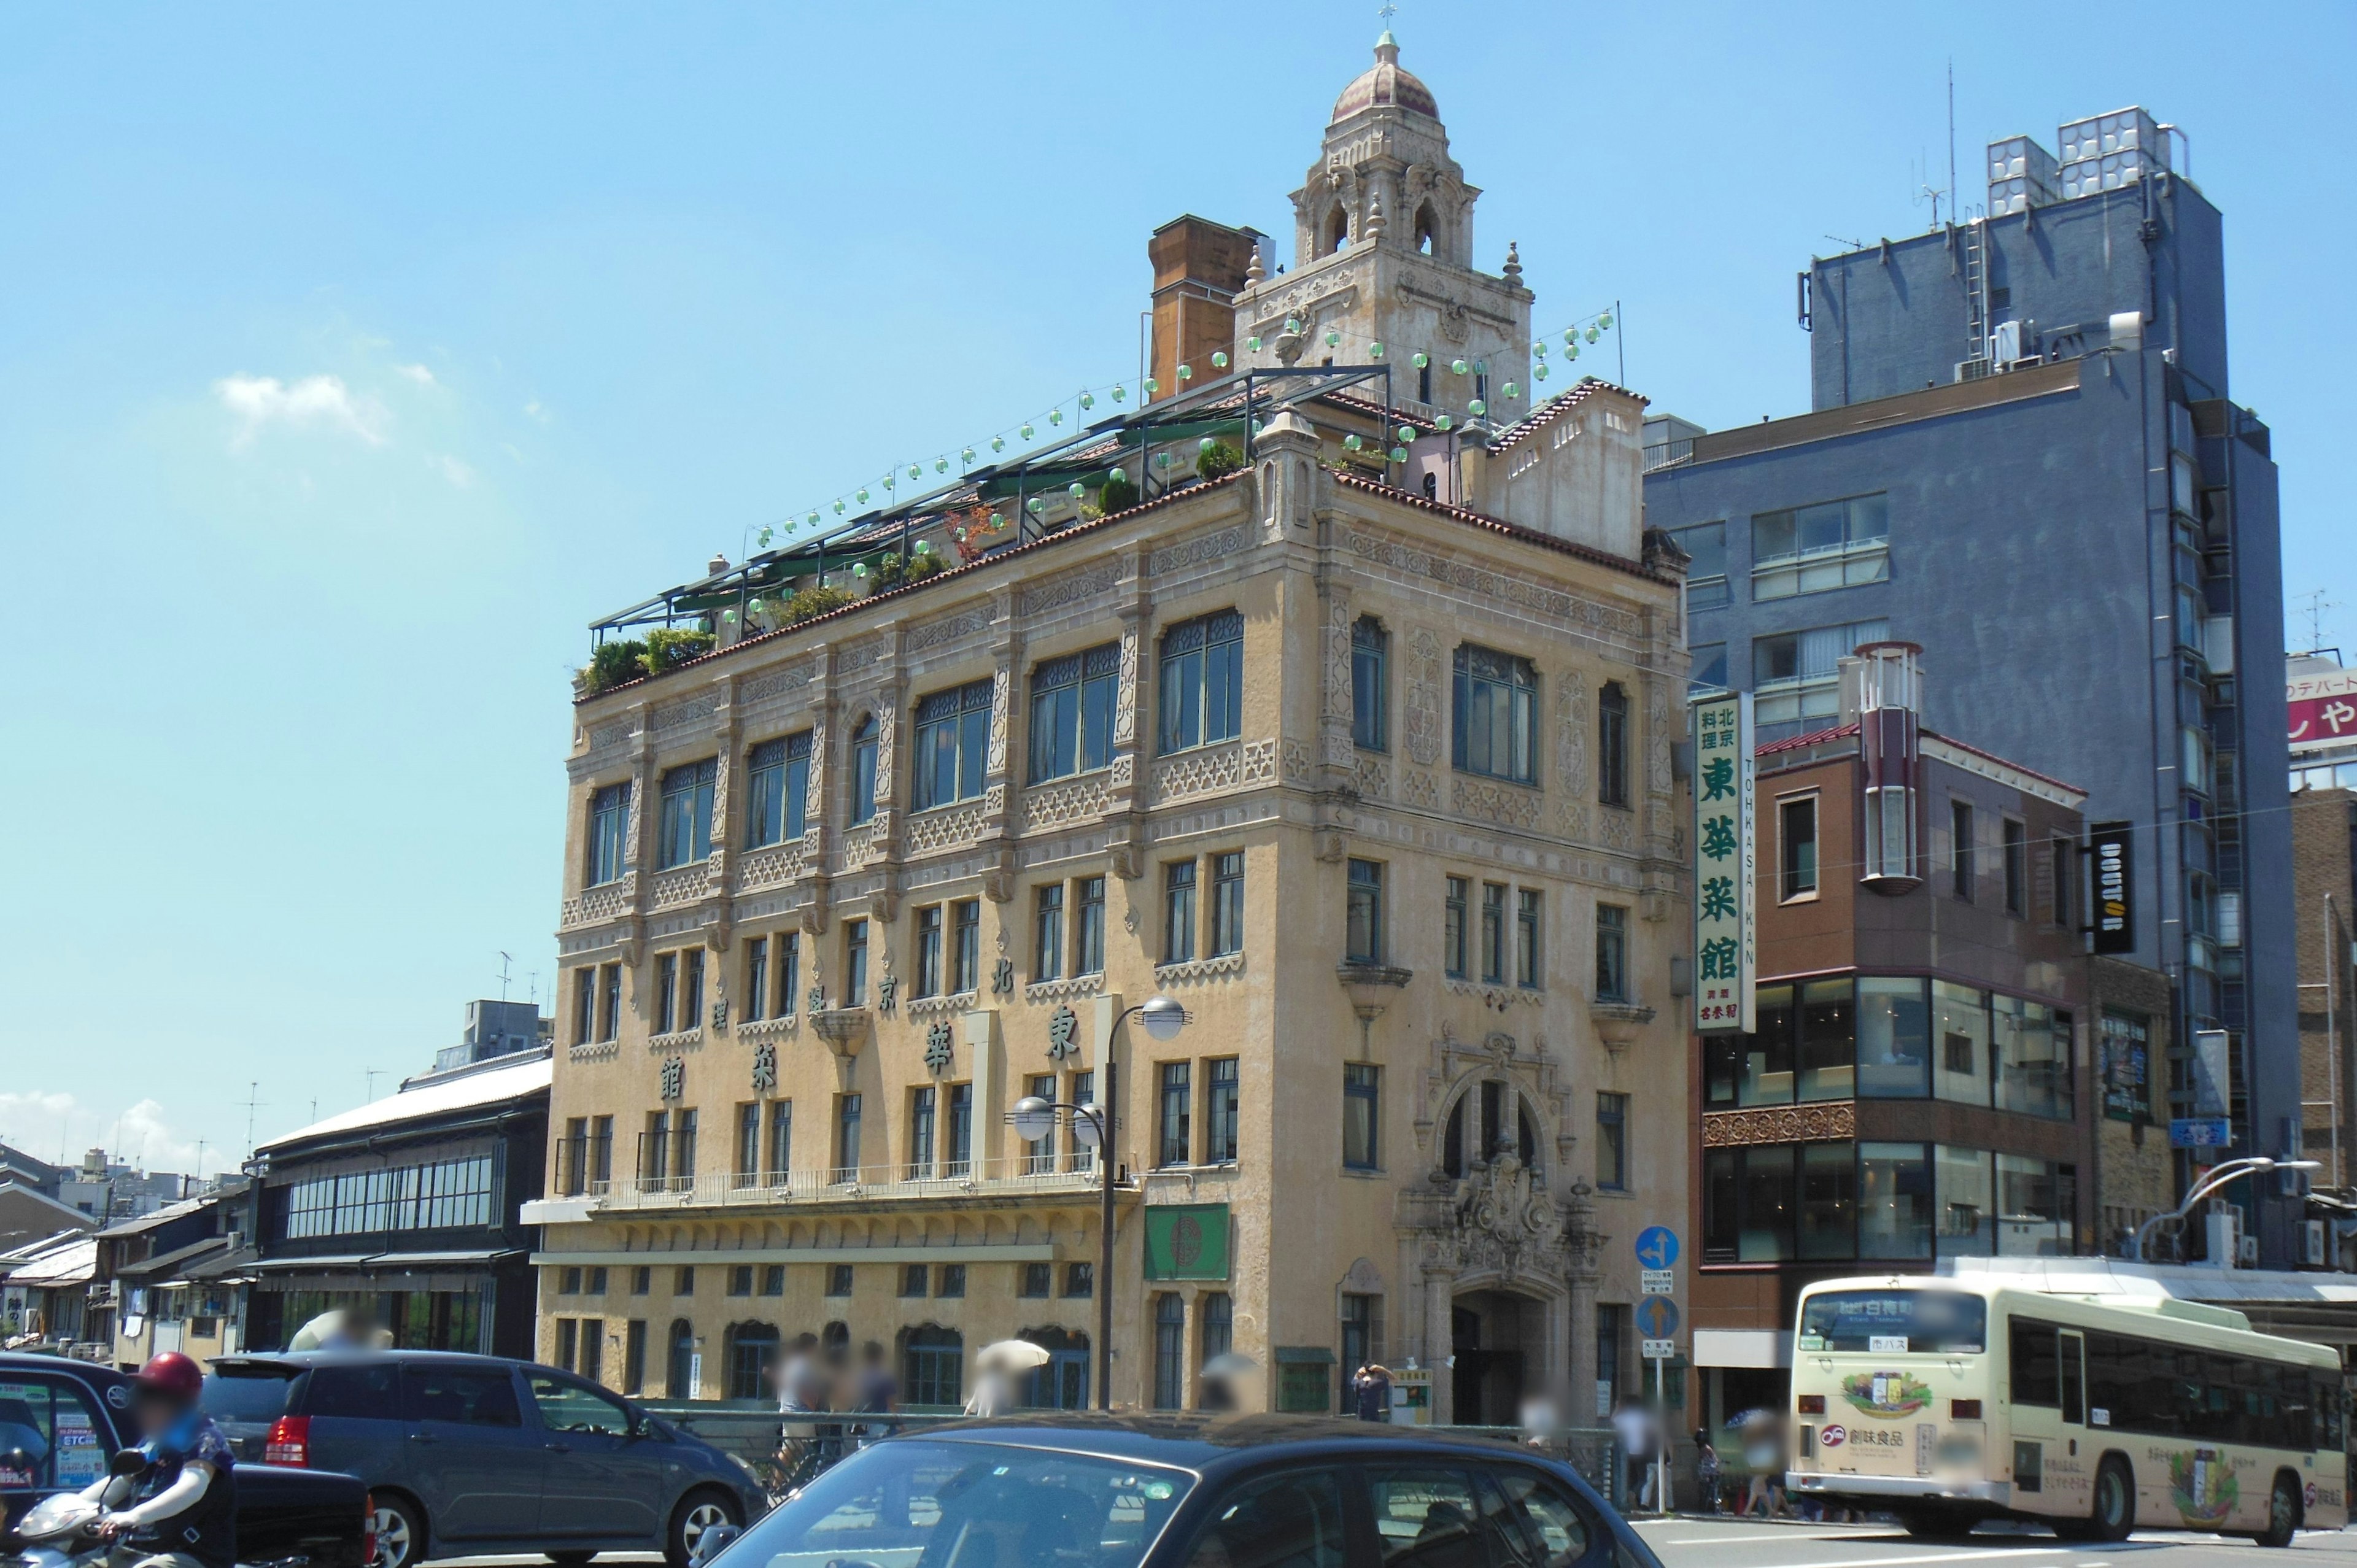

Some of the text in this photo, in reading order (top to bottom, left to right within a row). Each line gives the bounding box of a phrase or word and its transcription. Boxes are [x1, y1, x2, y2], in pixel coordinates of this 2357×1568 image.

[1700, 757, 1738, 982] 東華菜館
[1745, 759, 1754, 965] TOHKASAIKAN
[2100, 843, 2126, 931] DOUTOR
[1872, 1338, 1906, 1350] 市バス
